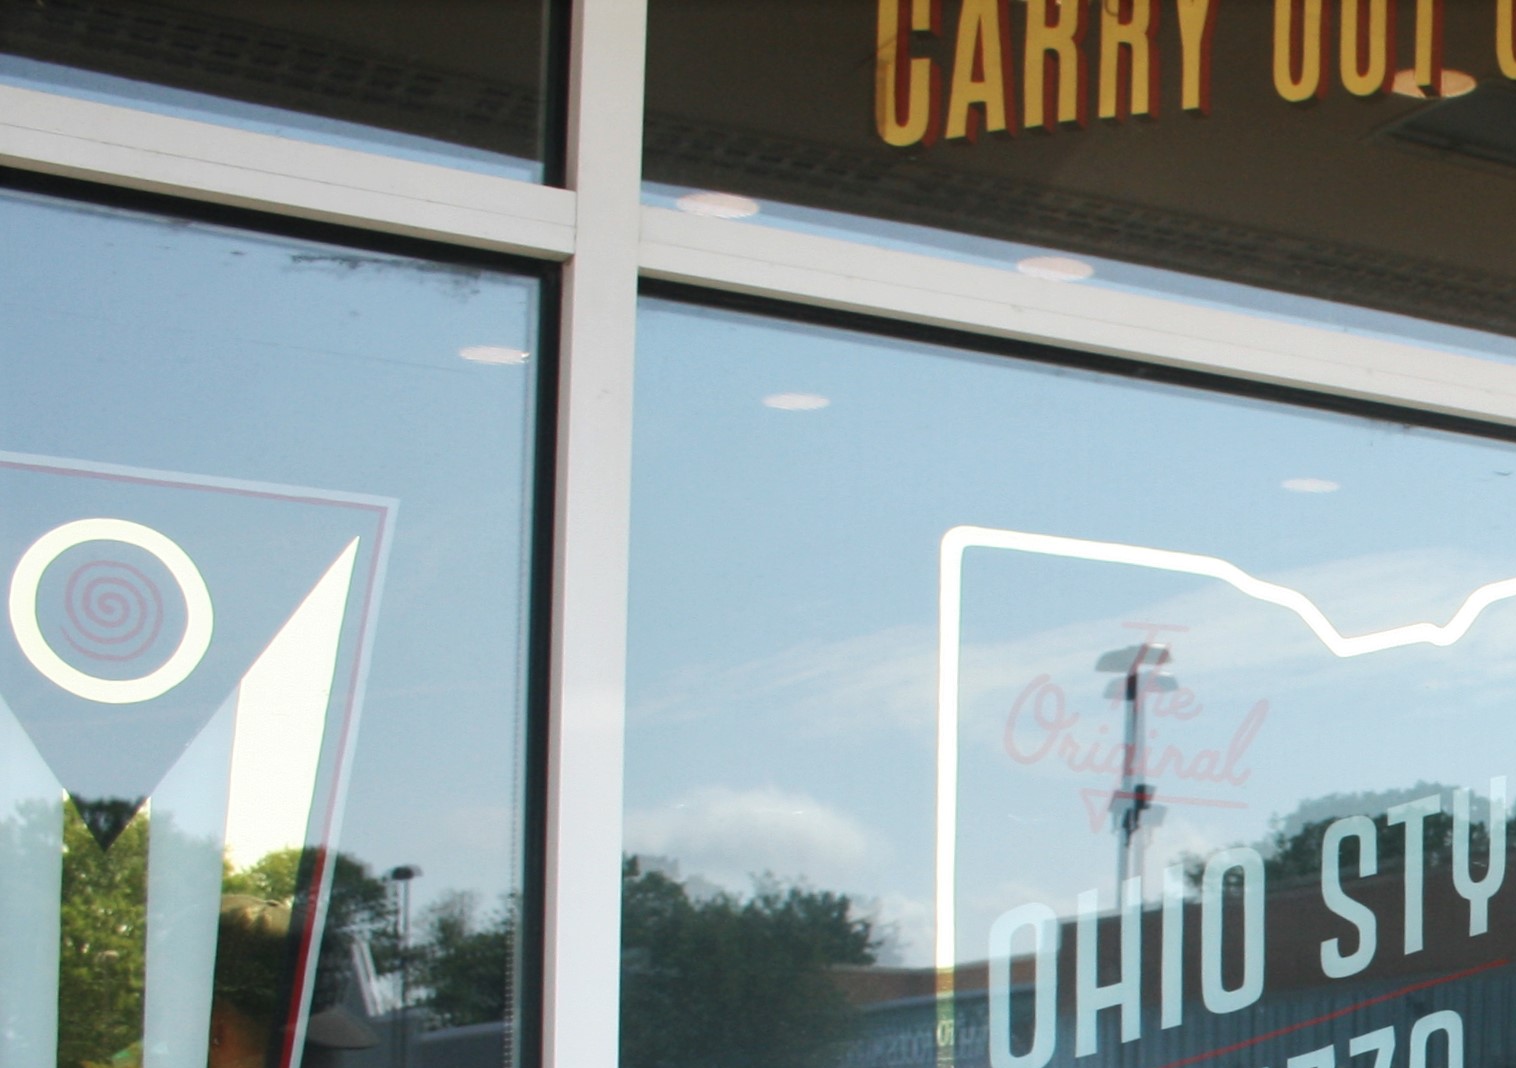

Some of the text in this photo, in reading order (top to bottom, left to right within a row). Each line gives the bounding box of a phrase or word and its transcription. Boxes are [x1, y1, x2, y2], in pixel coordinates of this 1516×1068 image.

[874, 0, 1213, 147] CARRY
[1110, 621, 1204, 723] The
[1003, 672, 1270, 833] Original
